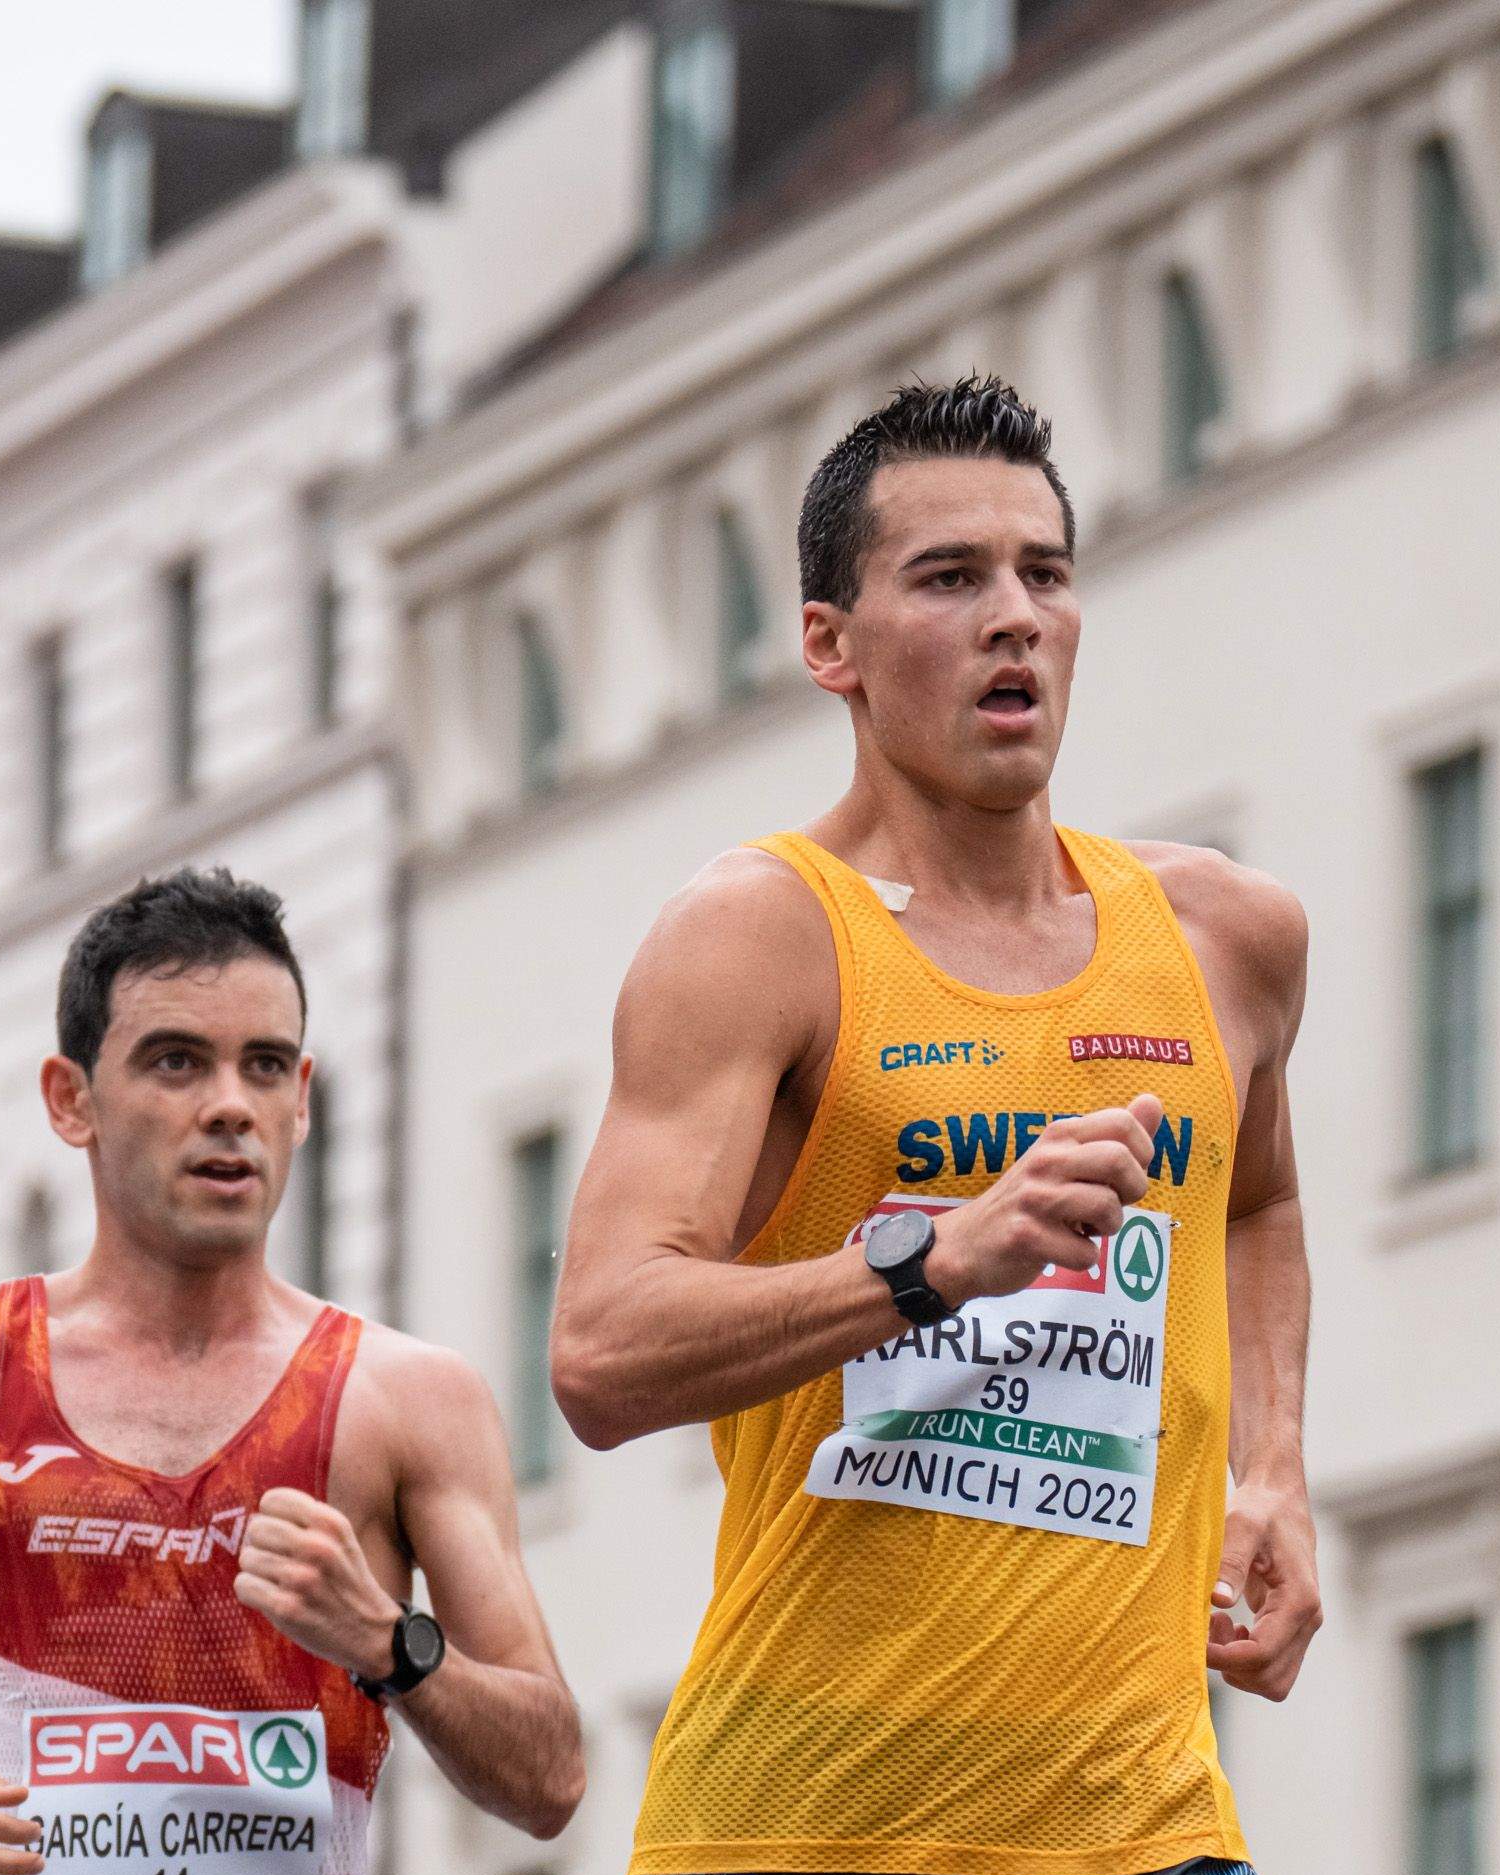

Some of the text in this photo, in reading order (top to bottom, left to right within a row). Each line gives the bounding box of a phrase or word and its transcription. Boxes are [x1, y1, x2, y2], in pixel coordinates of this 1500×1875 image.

[881, 1042, 976, 1071] CRAFT
[1071, 1035, 1191, 1061] BAUHAUS
[897, 1113, 1193, 1187] SWEN
[980, 1374, 1030, 1415] 59
[907, 1415, 918, 1437] I
[923, 1413, 984, 1442] RUN
[834, 1446, 1137, 1528] MUNICH 2022
[26, 1506, 252, 1564] ESPAÑ
[36, 1721, 242, 1776] SPAR
[160, 1811, 315, 1857] CARRERA
